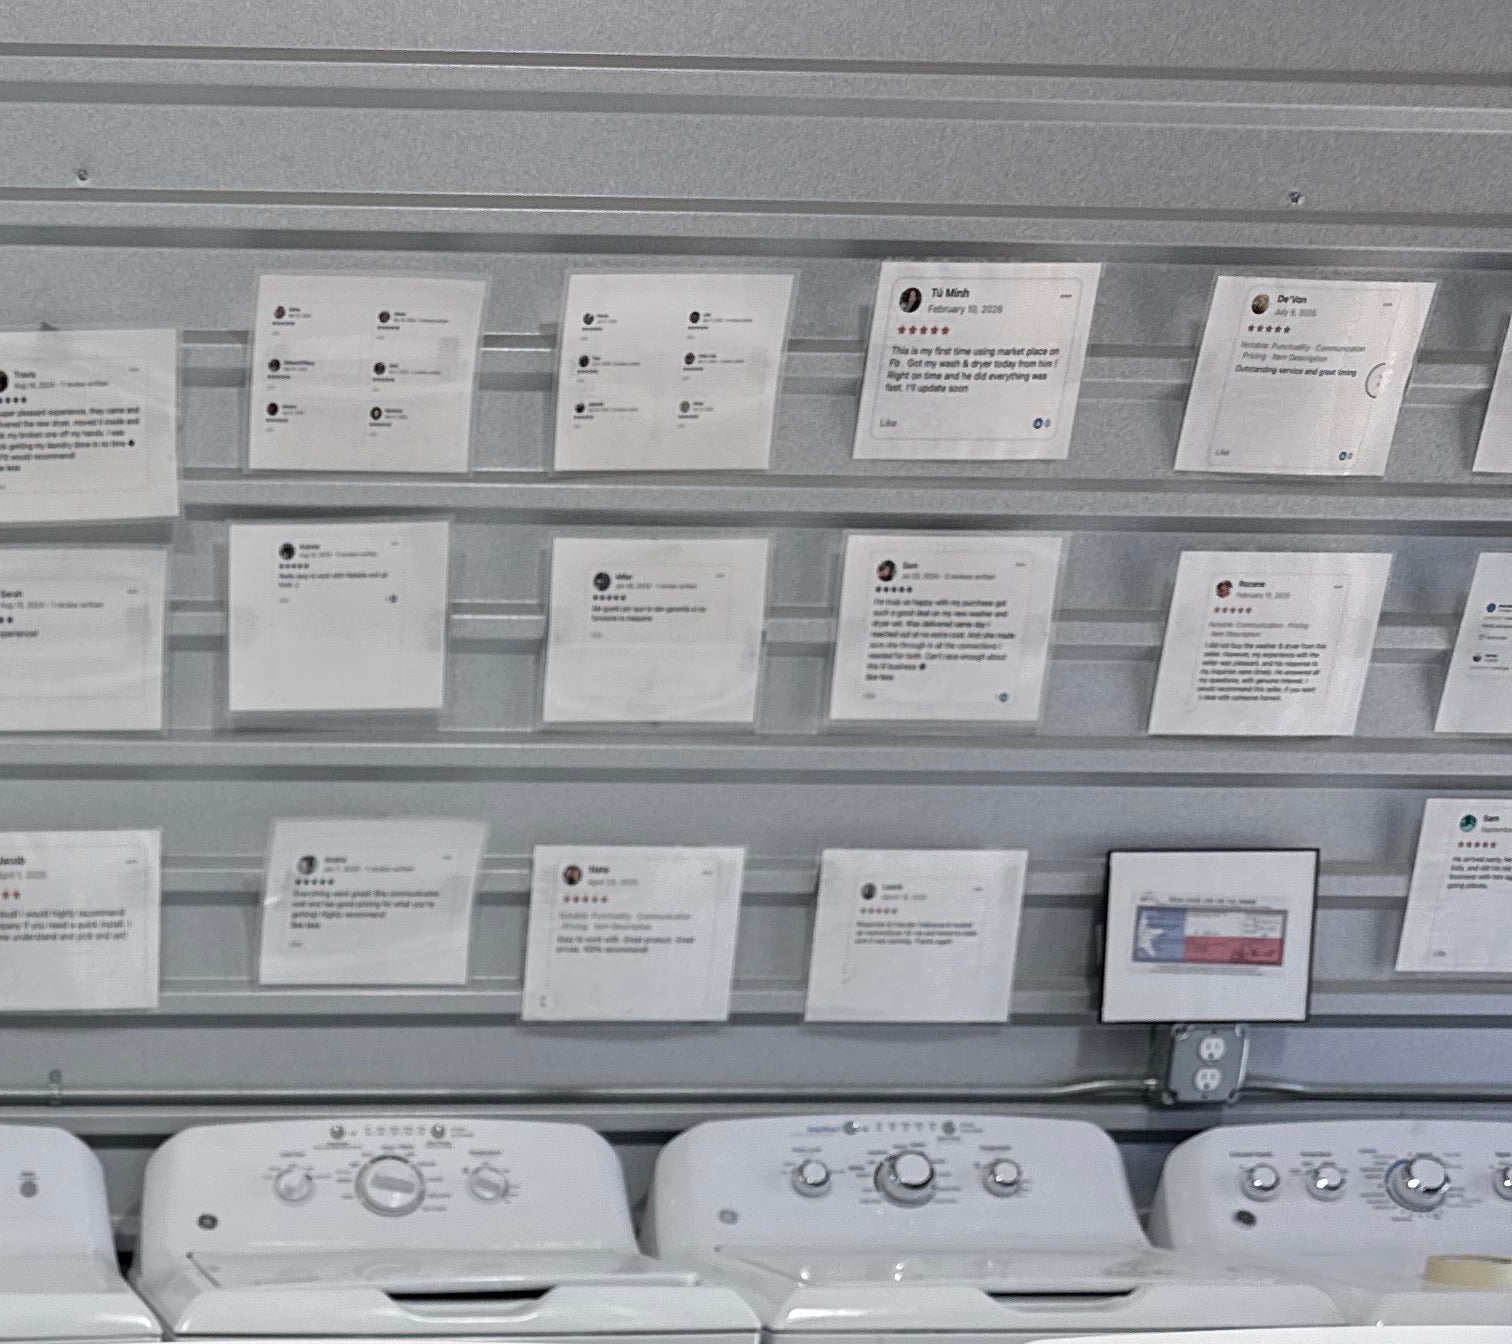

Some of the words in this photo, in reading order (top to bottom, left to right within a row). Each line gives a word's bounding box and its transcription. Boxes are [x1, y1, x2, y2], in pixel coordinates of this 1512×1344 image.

[928, 304, 965, 315] February
[892, 346, 909, 355] This
[911, 346, 918, 355] is
[920, 348, 933, 357] my
[935, 346, 952, 355] first
[954, 347, 971, 355] time
[973, 347, 996, 358] using
[997, 347, 1026, 356] market
[1026, 348, 1048, 357] place
[1049, 348, 1060, 356] on
[1271, 342, 1310, 352] Punctuality
[1315, 344, 1366, 353] Communication
[924, 360, 937, 369] my
[939, 359, 960, 368] wash
[970, 359, 993, 370] dryer
[994, 360, 1016, 369] today
[1017, 359, 1037, 367] from
[1038, 360, 1053, 368] him
[886, 370, 910, 382] Right
[911, 372, 922, 380] on
[924, 371, 942, 380] time
[944, 371, 959, 380] and
[961, 371, 972, 380] he
[974, 371, 987, 380] did
[988, 372, 1030, 382] everything
[1235, 364, 1277, 375] Outstanding
[1278, 367, 1303, 375] service
[1304, 368, 1318, 376] and
[1319, 369, 1336, 377] great
[1337, 369, 1357, 377] timing
[917, 384, 946, 394] update
